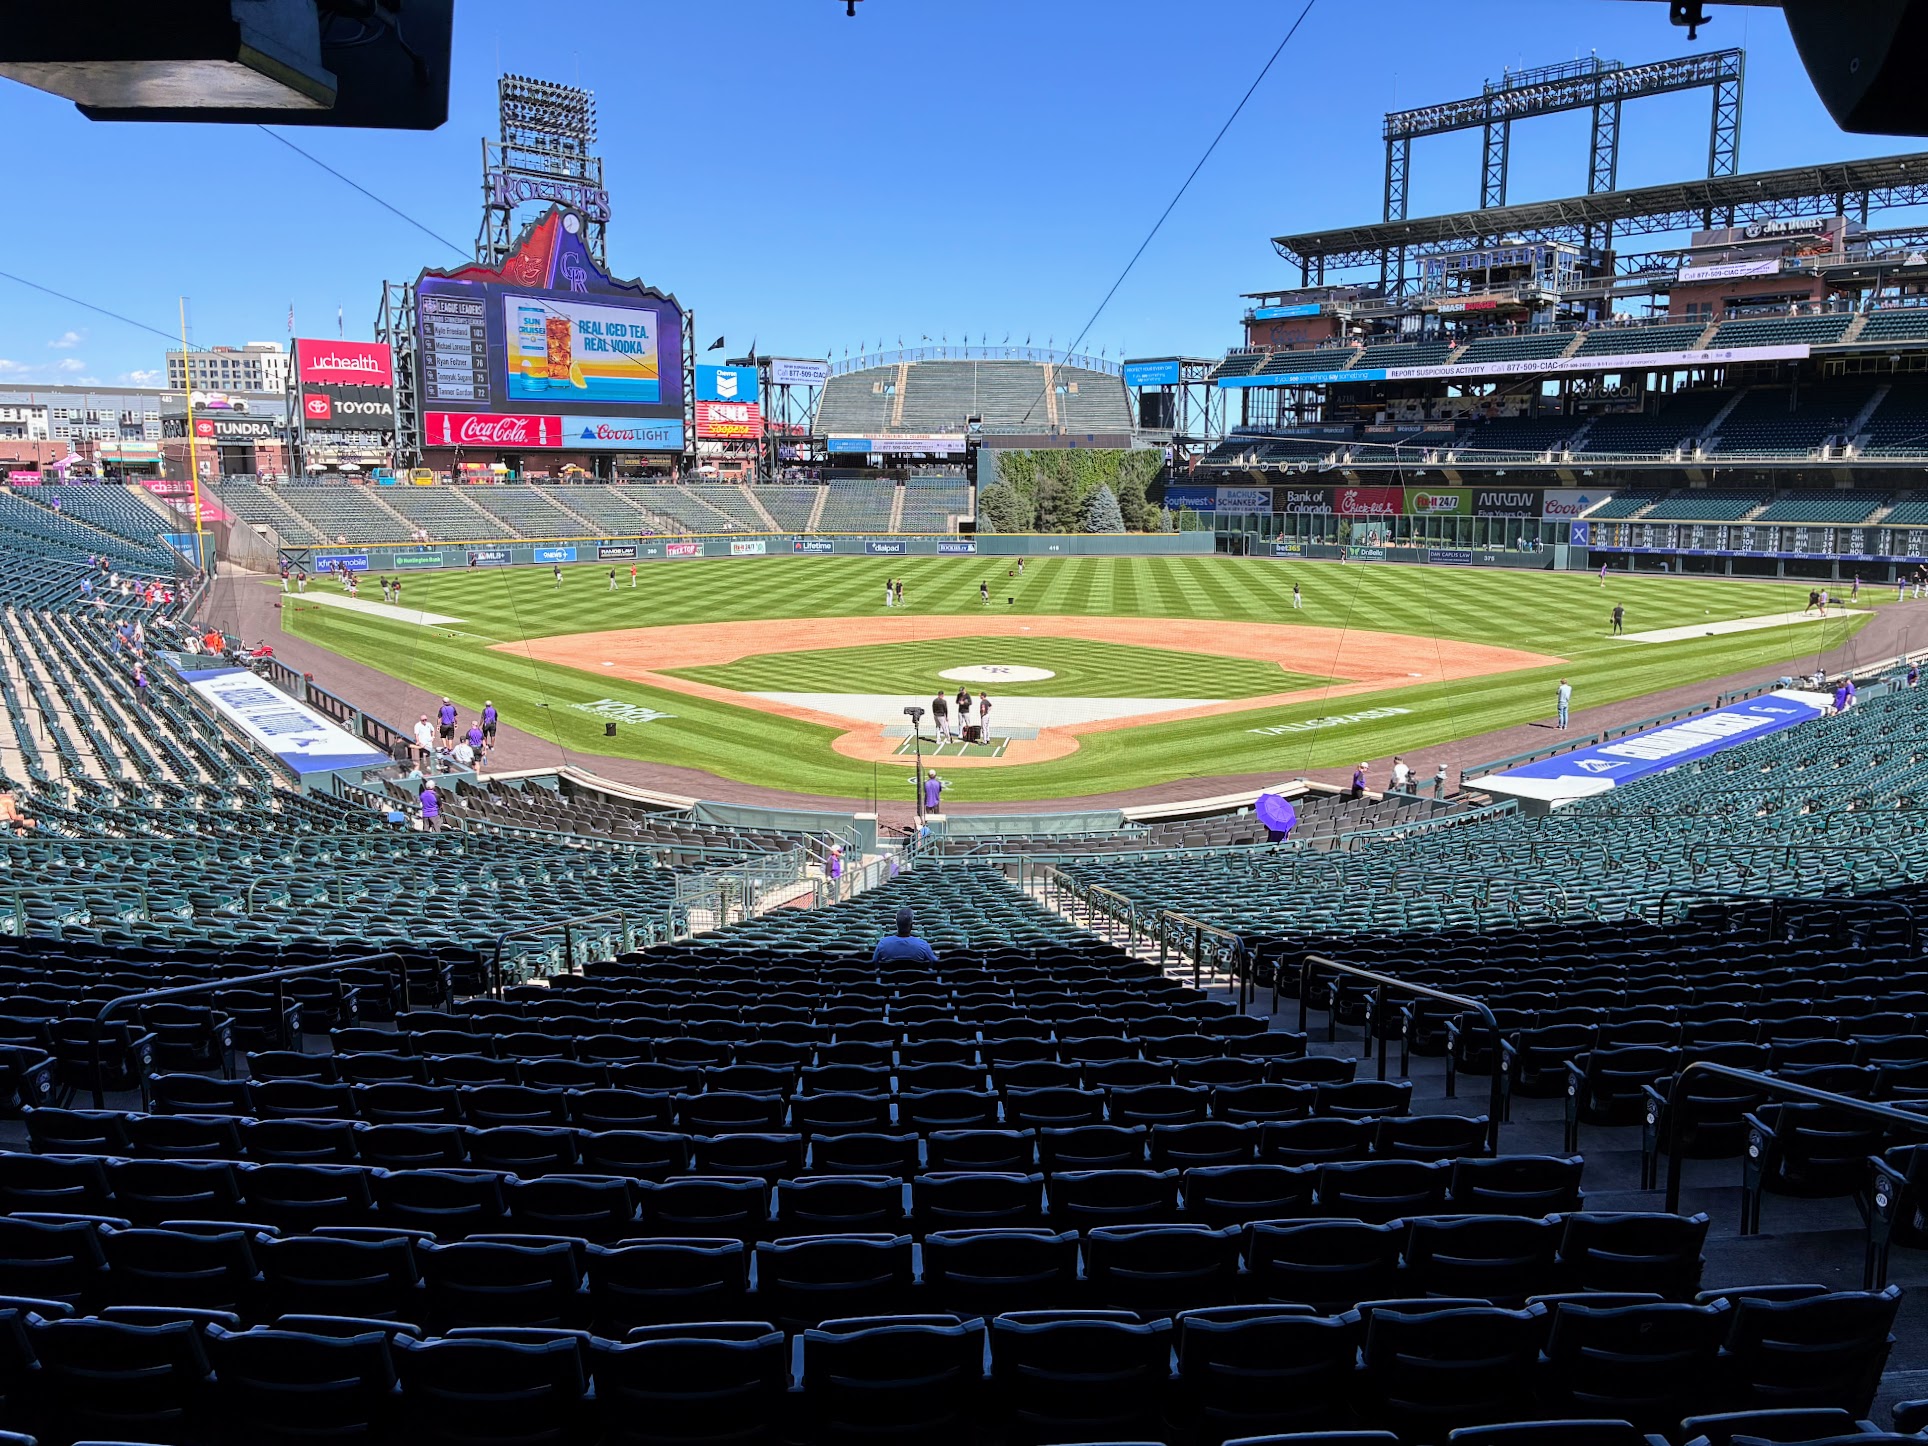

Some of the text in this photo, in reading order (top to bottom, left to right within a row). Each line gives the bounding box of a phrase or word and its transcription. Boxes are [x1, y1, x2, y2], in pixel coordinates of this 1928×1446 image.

[482, 172, 612, 222] ROCKIES
[1460, 246, 1545, 271] ROOFTOP
[438, 302, 483, 315] LEAGUE LEADERS
[1438, 300, 1498, 312] SMASHBURGER
[523, 317, 541, 326] SUN
[434, 326, 446, 336] Kyle
[578, 320, 649, 339] REAL ICED TEA.
[584, 336, 646, 354] REAL VODKA.
[313, 352, 379, 371] uchealth
[436, 357, 449, 366] Ryan
[1391, 370, 1416, 378] REPORT
[1416, 368, 1454, 376] SUSPICIOUS
[1455, 366, 1485, 374] ACTIVITY
[1506, 362, 1558, 372] 877-509-CIAC
[334, 401, 393, 415] TOYOTA
[214, 422, 270, 435] TUNDRA
[460, 416, 529, 443] Coca-Cola
[596, 424, 669, 441] Coors LIGHT
[709, 420, 750, 438] Soopers
[1227, 490, 1257, 498] BACHUS
[1287, 490, 1324, 502] Bank of
[1164, 496, 1208, 506] Southwest
[1218, 499, 1257, 507] SCHANKER
[1439, 496, 1458, 507] 24/7
[1286, 502, 1332, 513] Colorado
[1573, 528, 1586, 543] X
[803, 542, 831, 550] Lifetime
[875, 544, 899, 552] dialpad
[1276, 544, 1300, 552] bet365
